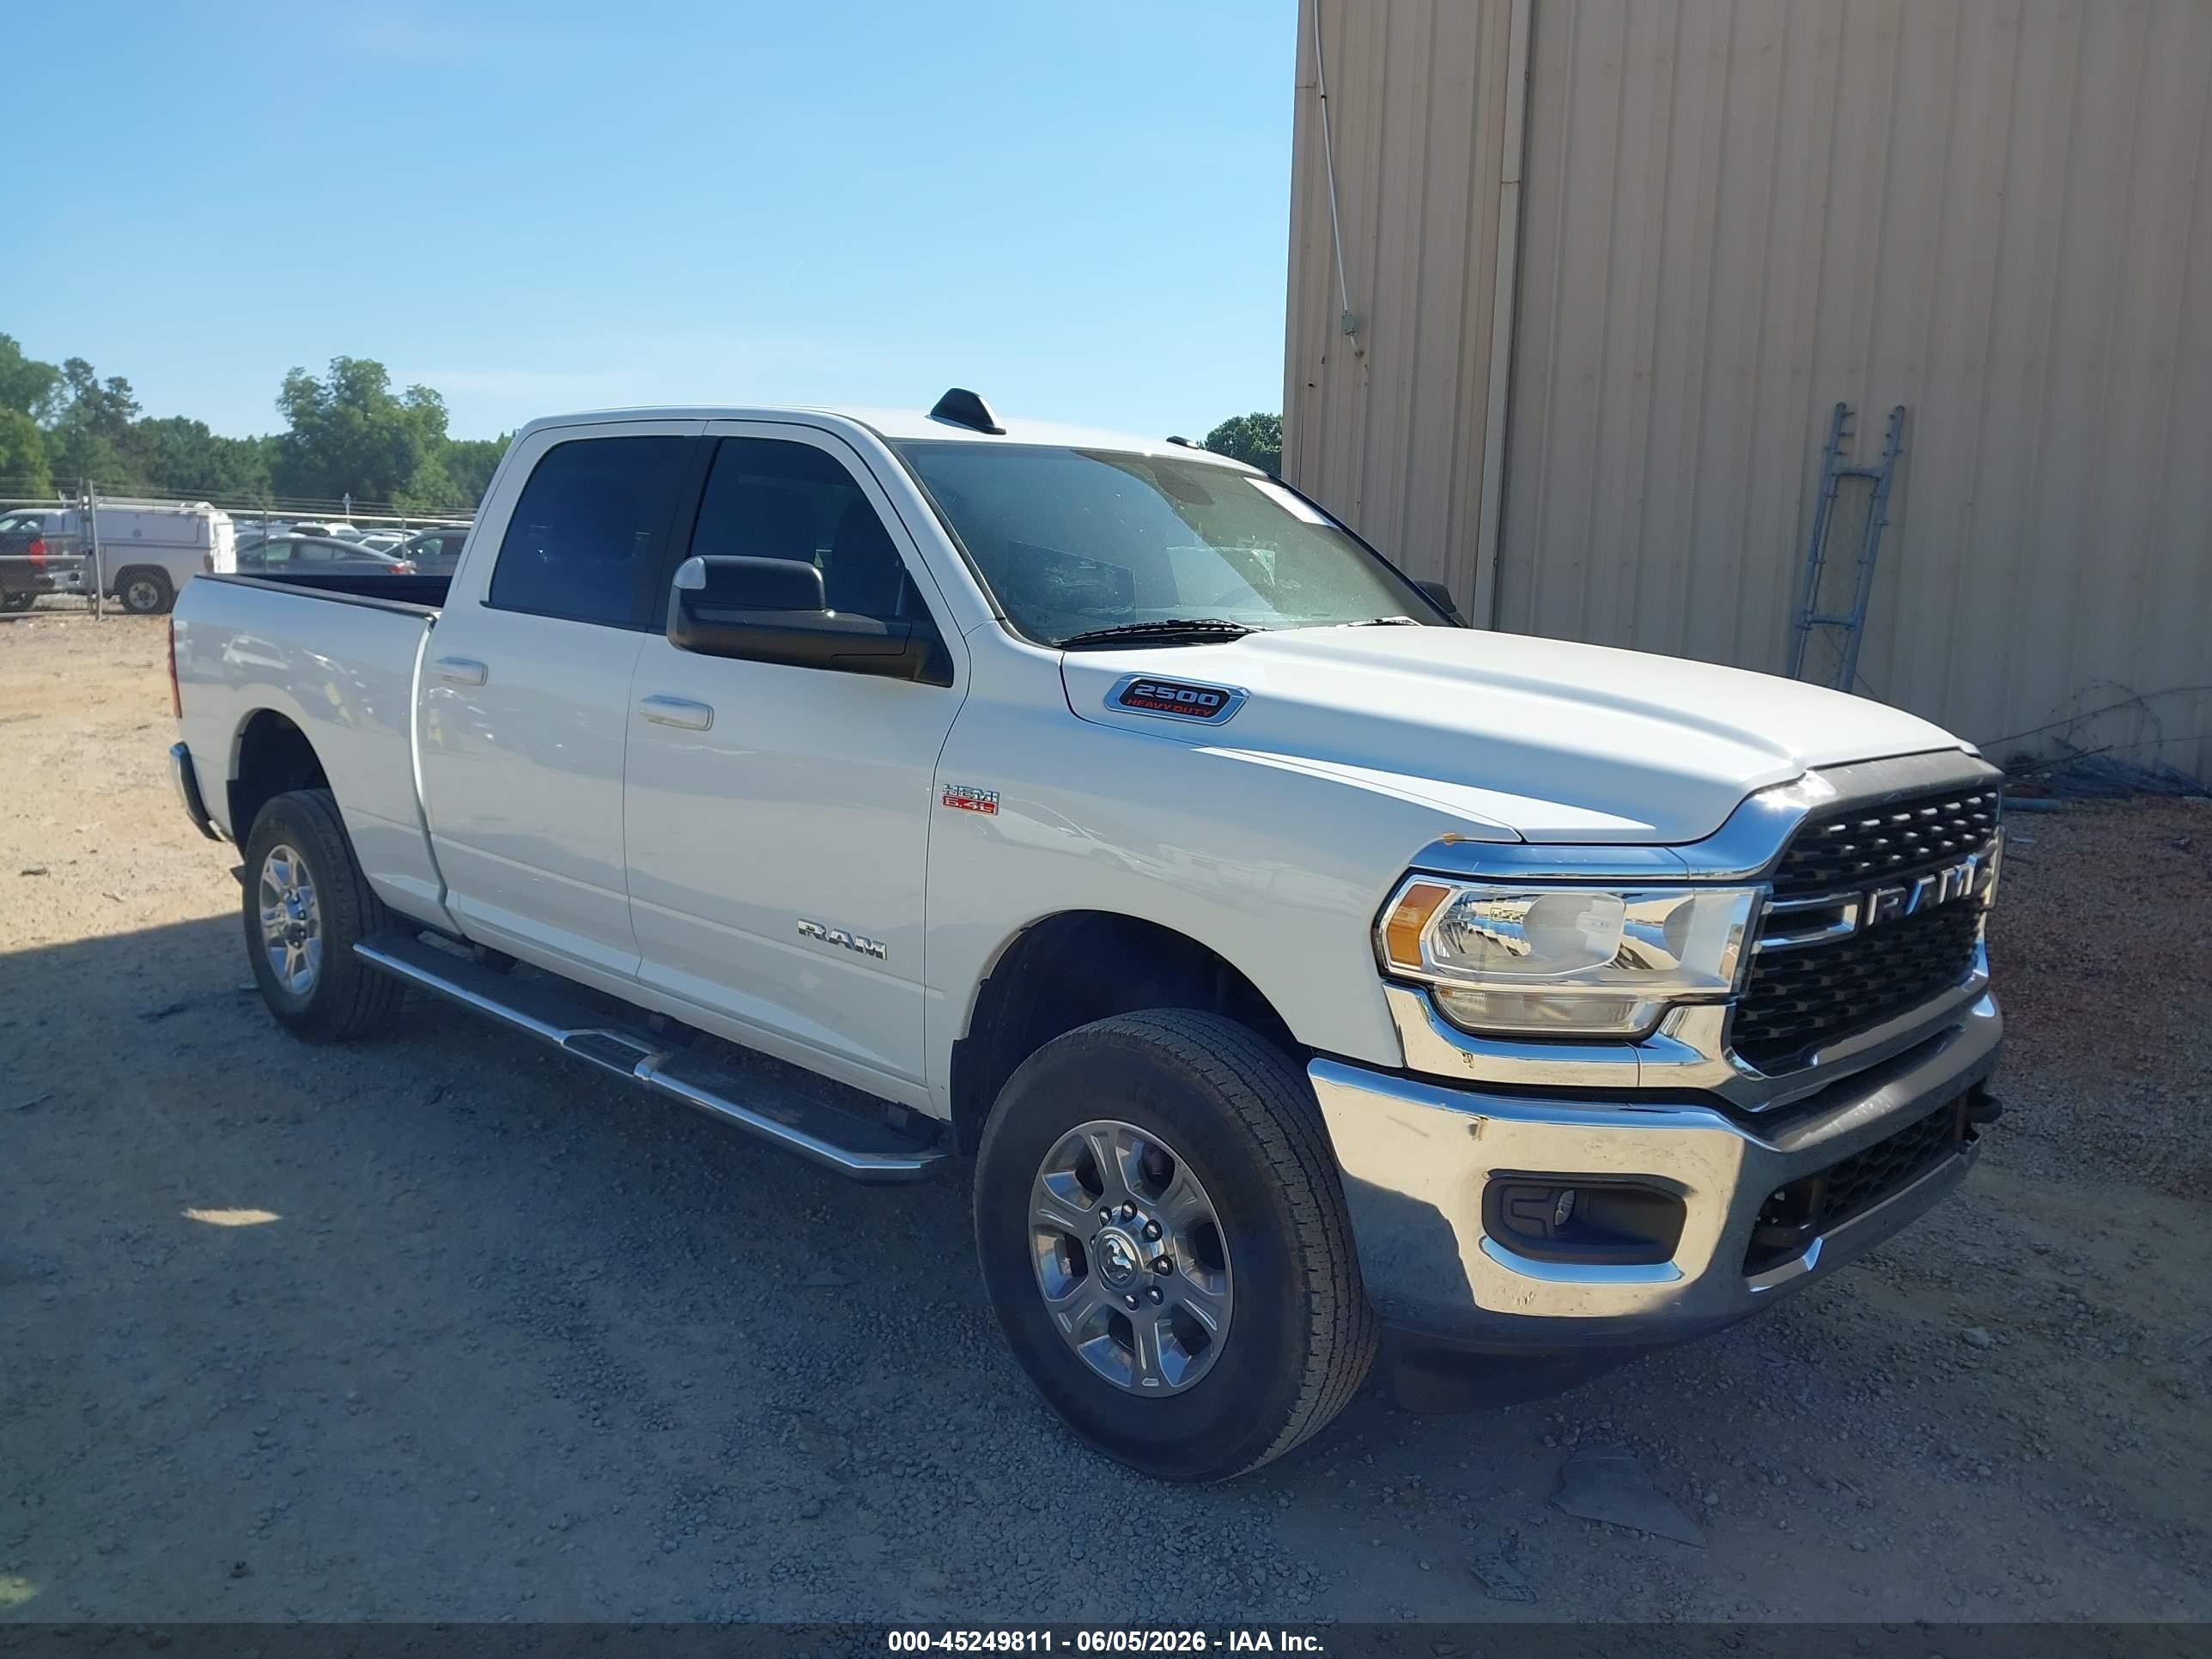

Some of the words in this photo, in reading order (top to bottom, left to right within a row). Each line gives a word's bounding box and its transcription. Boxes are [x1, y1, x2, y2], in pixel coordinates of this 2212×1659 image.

[1134, 684, 1219, 706] 2500
[1127, 699, 1172, 710] HEAVY
[1173, 704, 1212, 716] DUTY
[943, 784, 1000, 803] HEMI
[1865, 854, 1978, 925] RAM
[798, 919, 888, 960] RAM
